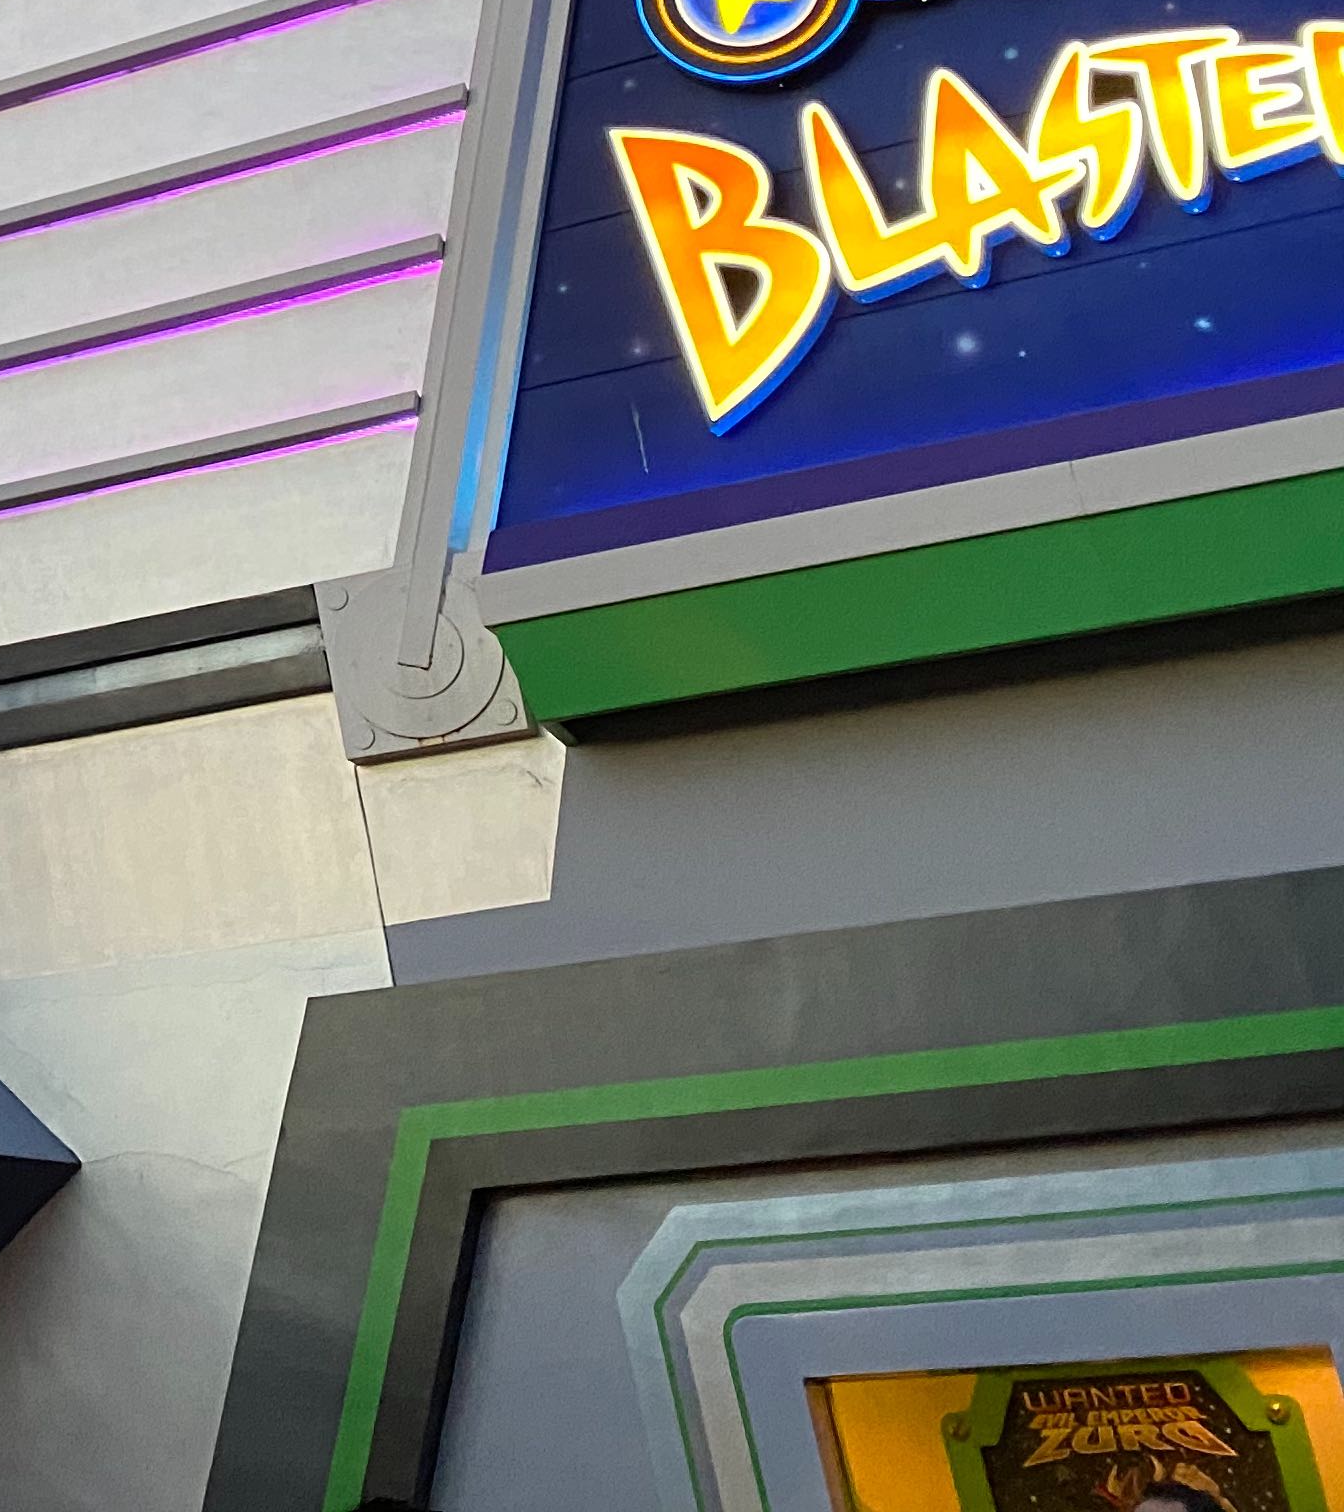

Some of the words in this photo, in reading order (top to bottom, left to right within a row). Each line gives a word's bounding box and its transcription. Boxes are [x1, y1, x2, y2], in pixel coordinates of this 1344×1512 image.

[1023, 1382, 1192, 1412] WANTED
[1086, 1405, 1208, 1428] EMPEROR
[1023, 1420, 1239, 1468] ZURG
